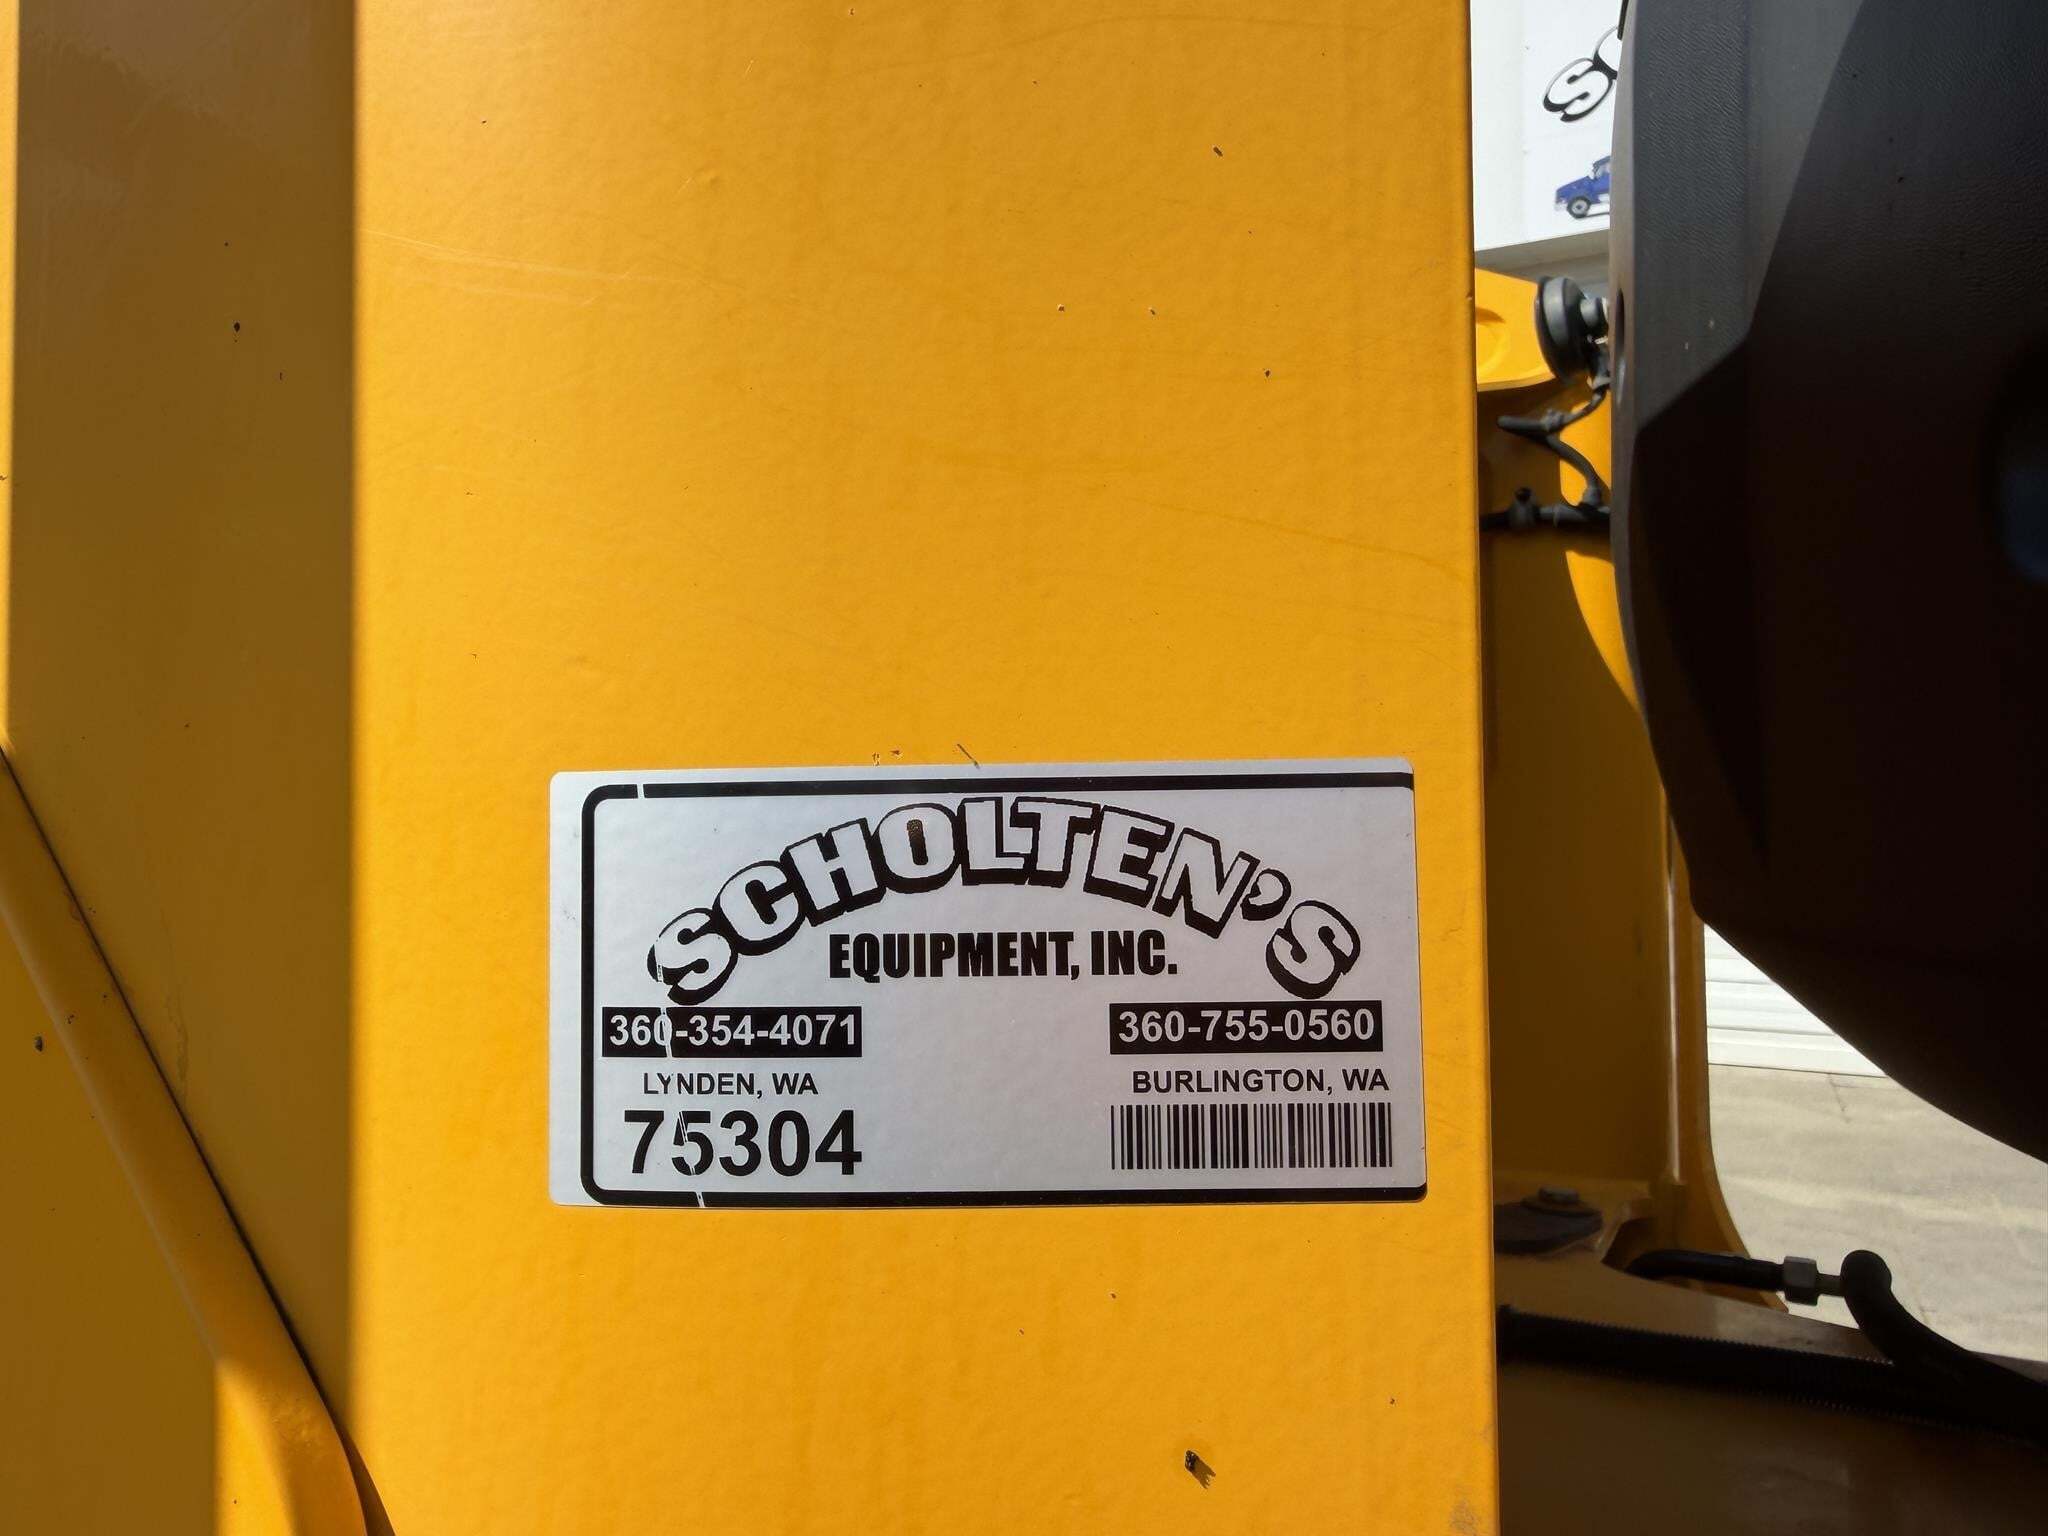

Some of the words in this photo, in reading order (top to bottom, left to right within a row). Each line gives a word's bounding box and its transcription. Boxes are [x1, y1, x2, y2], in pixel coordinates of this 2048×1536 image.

[647, 797, 1361, 1005] SCHOLTEN'S
[829, 931, 1080, 983] EQUIPMENT,
[1091, 930, 1178, 975] INC.
[609, 1013, 857, 1046] 360-354-4071
[1118, 1008, 1375, 1043] 360-755-0560
[643, 1072, 763, 1099] LYNDEN,
[771, 1072, 819, 1095] WA
[1132, 1069, 1333, 1095] BURLINGTON,
[1342, 1068, 1390, 1091] WA
[624, 1110, 862, 1176] 75304
